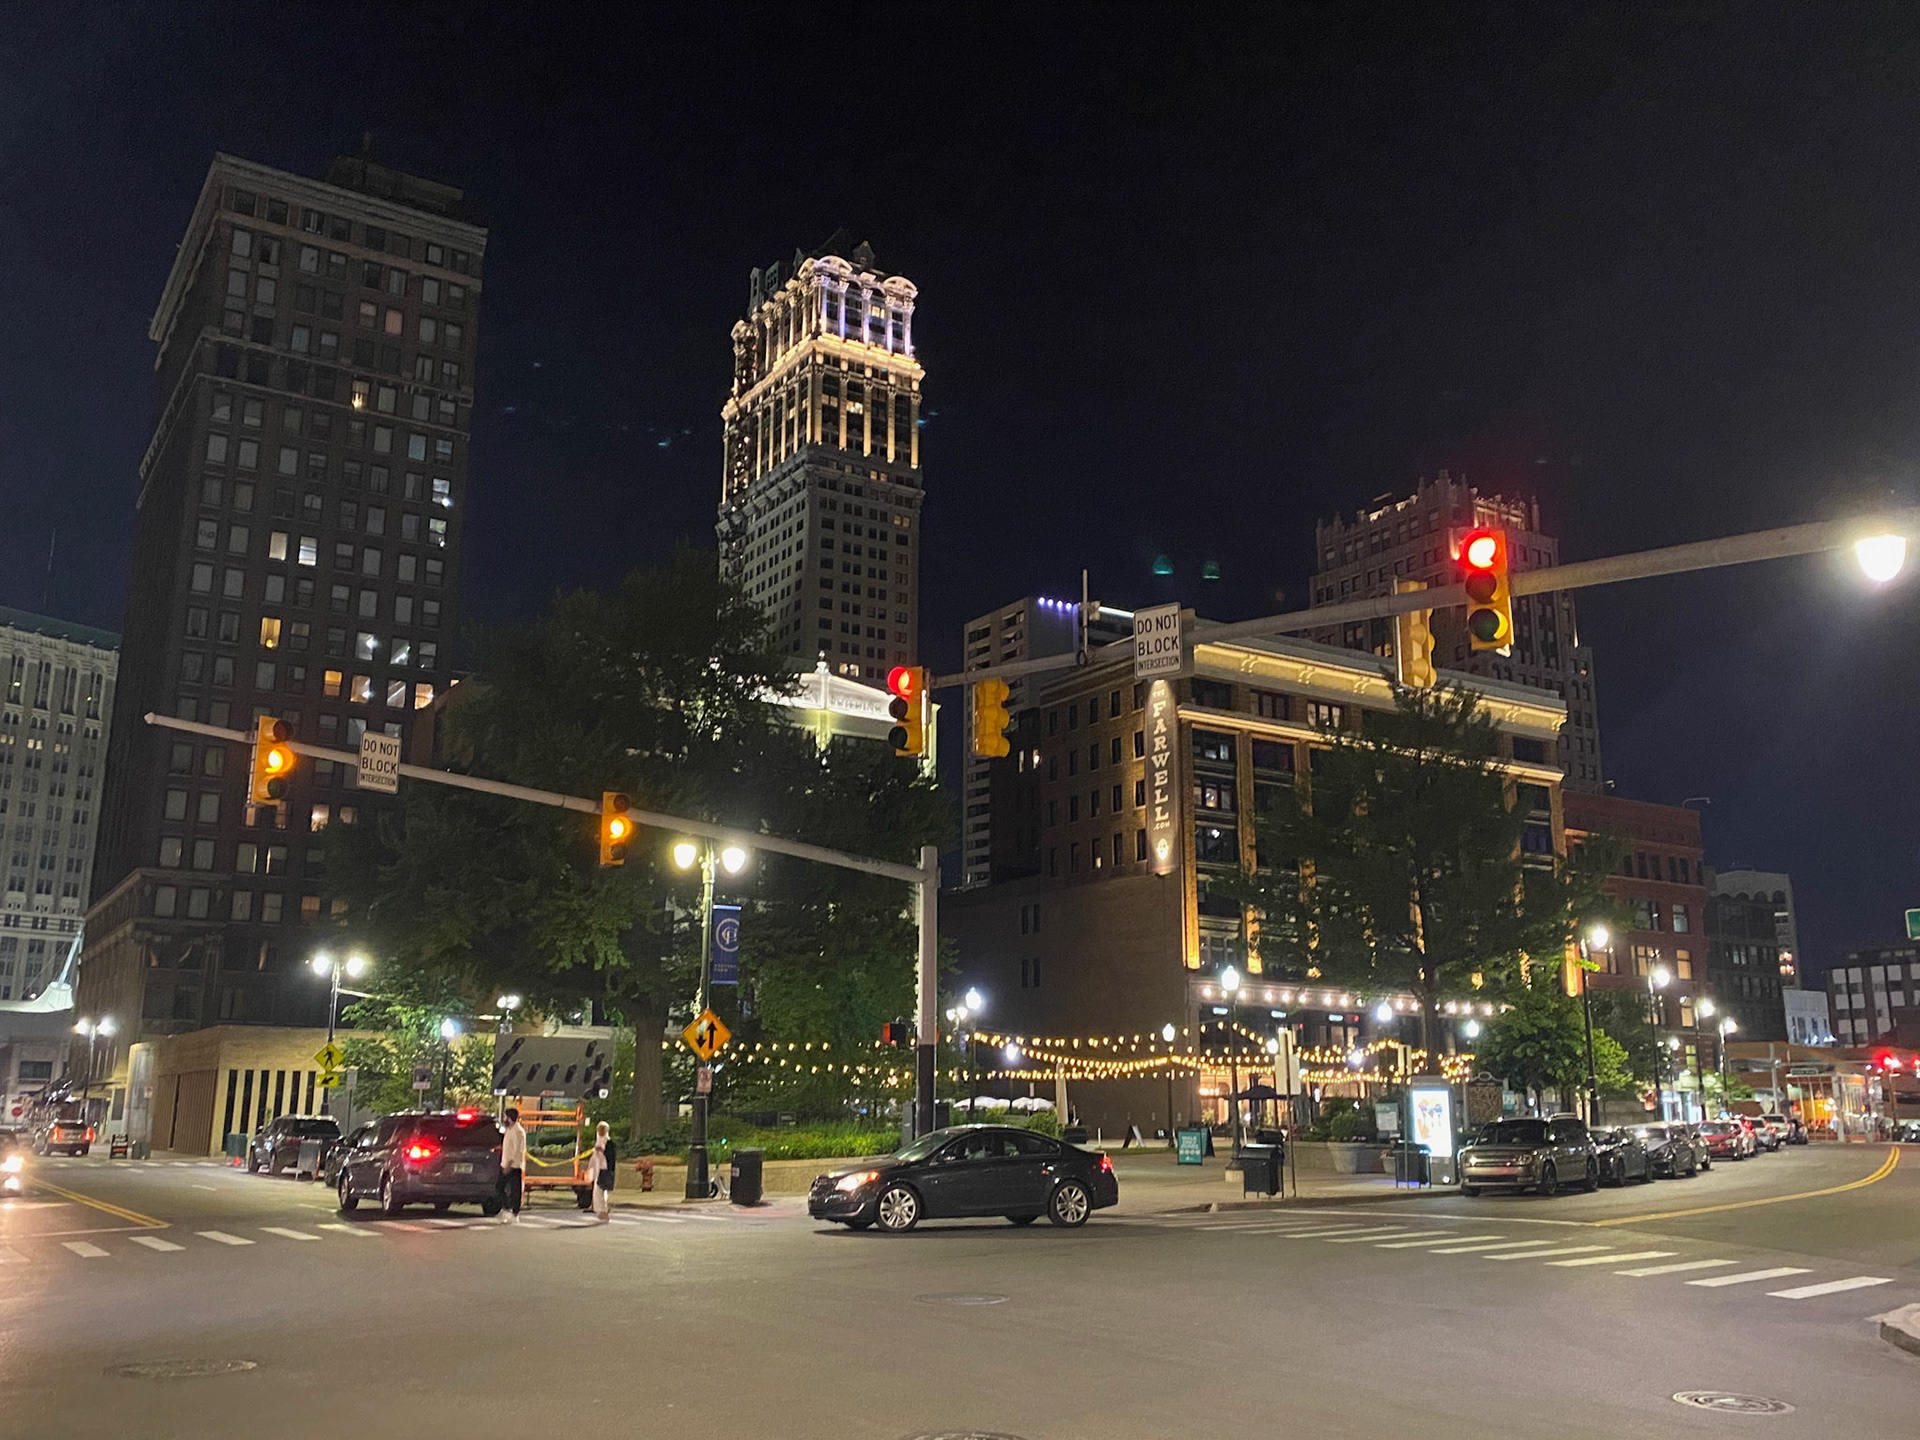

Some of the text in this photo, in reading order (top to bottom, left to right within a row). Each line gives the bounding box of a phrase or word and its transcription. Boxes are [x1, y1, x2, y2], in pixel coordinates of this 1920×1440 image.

[1137, 613, 1178, 634] DO NOT
[1138, 635, 1179, 656] BLOCK
[1138, 655, 1179, 671] INTERSECTION
[364, 739, 398, 756] DO NOT
[362, 757, 397, 774] BLOCK
[1151, 700, 1170, 822] FARWELL
[361, 774, 396, 786] INTERSECTION
